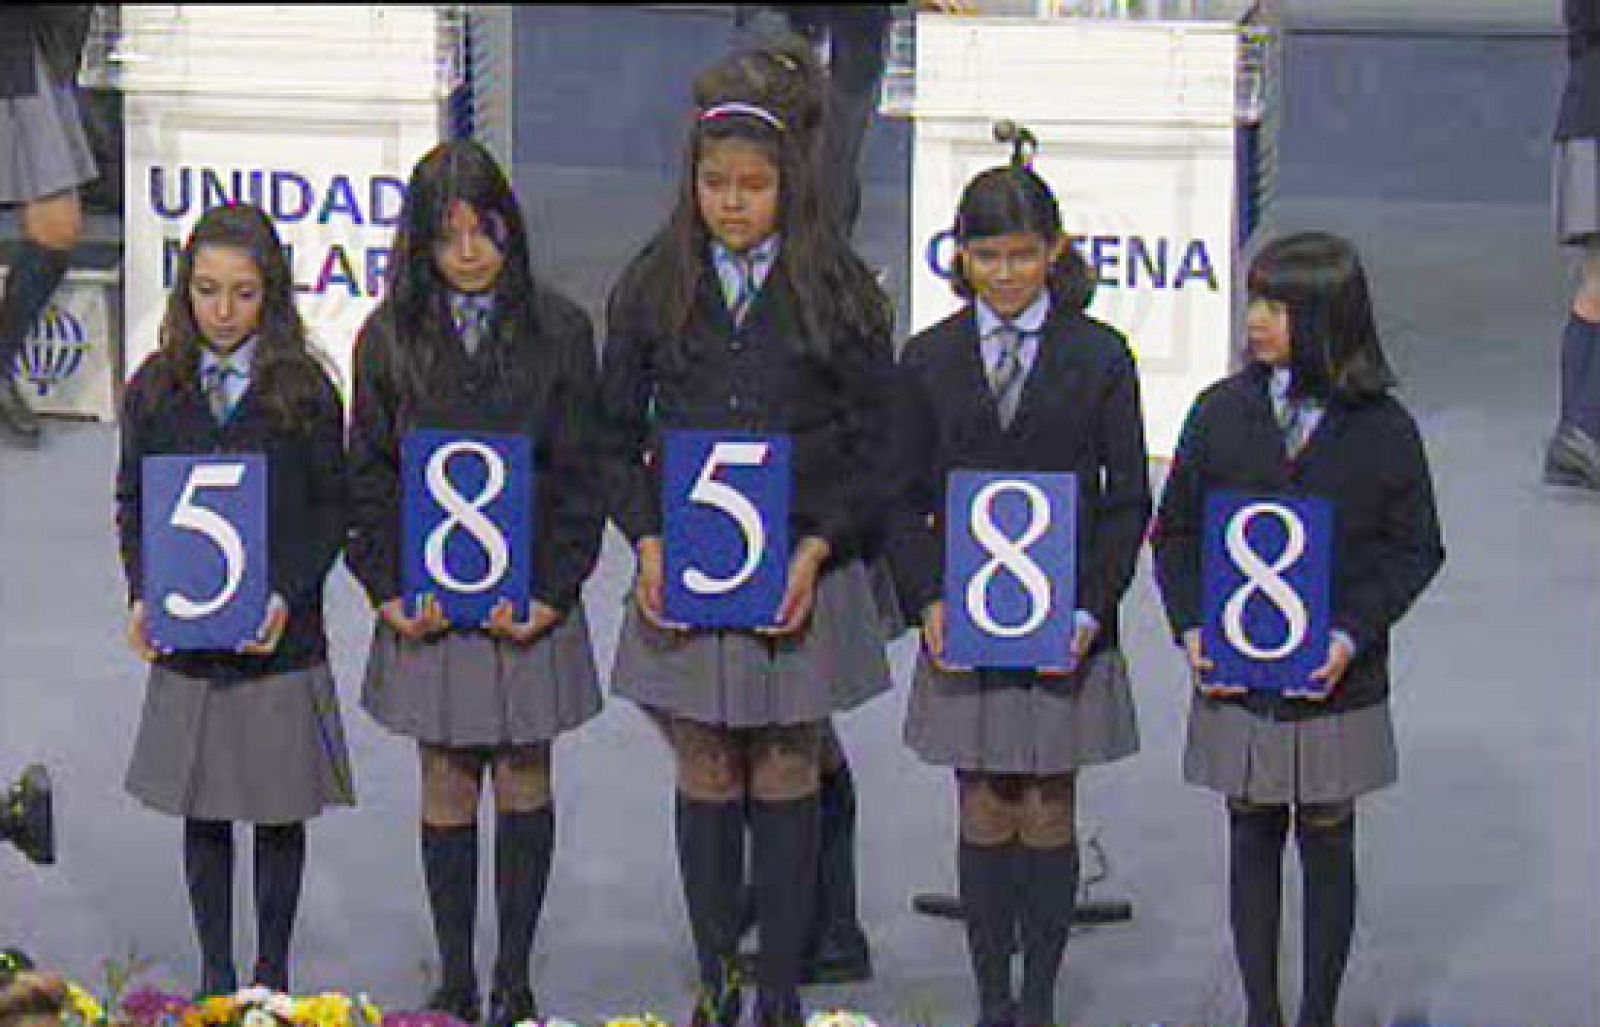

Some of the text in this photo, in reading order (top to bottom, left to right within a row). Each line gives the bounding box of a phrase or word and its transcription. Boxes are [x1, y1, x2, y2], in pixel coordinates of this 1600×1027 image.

[149, 166, 409, 225] UNIDAD
[926, 229, 1219, 291] CENA
[165, 463, 246, 618] 5
[424, 440, 508, 592] 8
[683, 441, 769, 594] 5
[965, 479, 1051, 638] 8
[1223, 502, 1307, 659] 8
